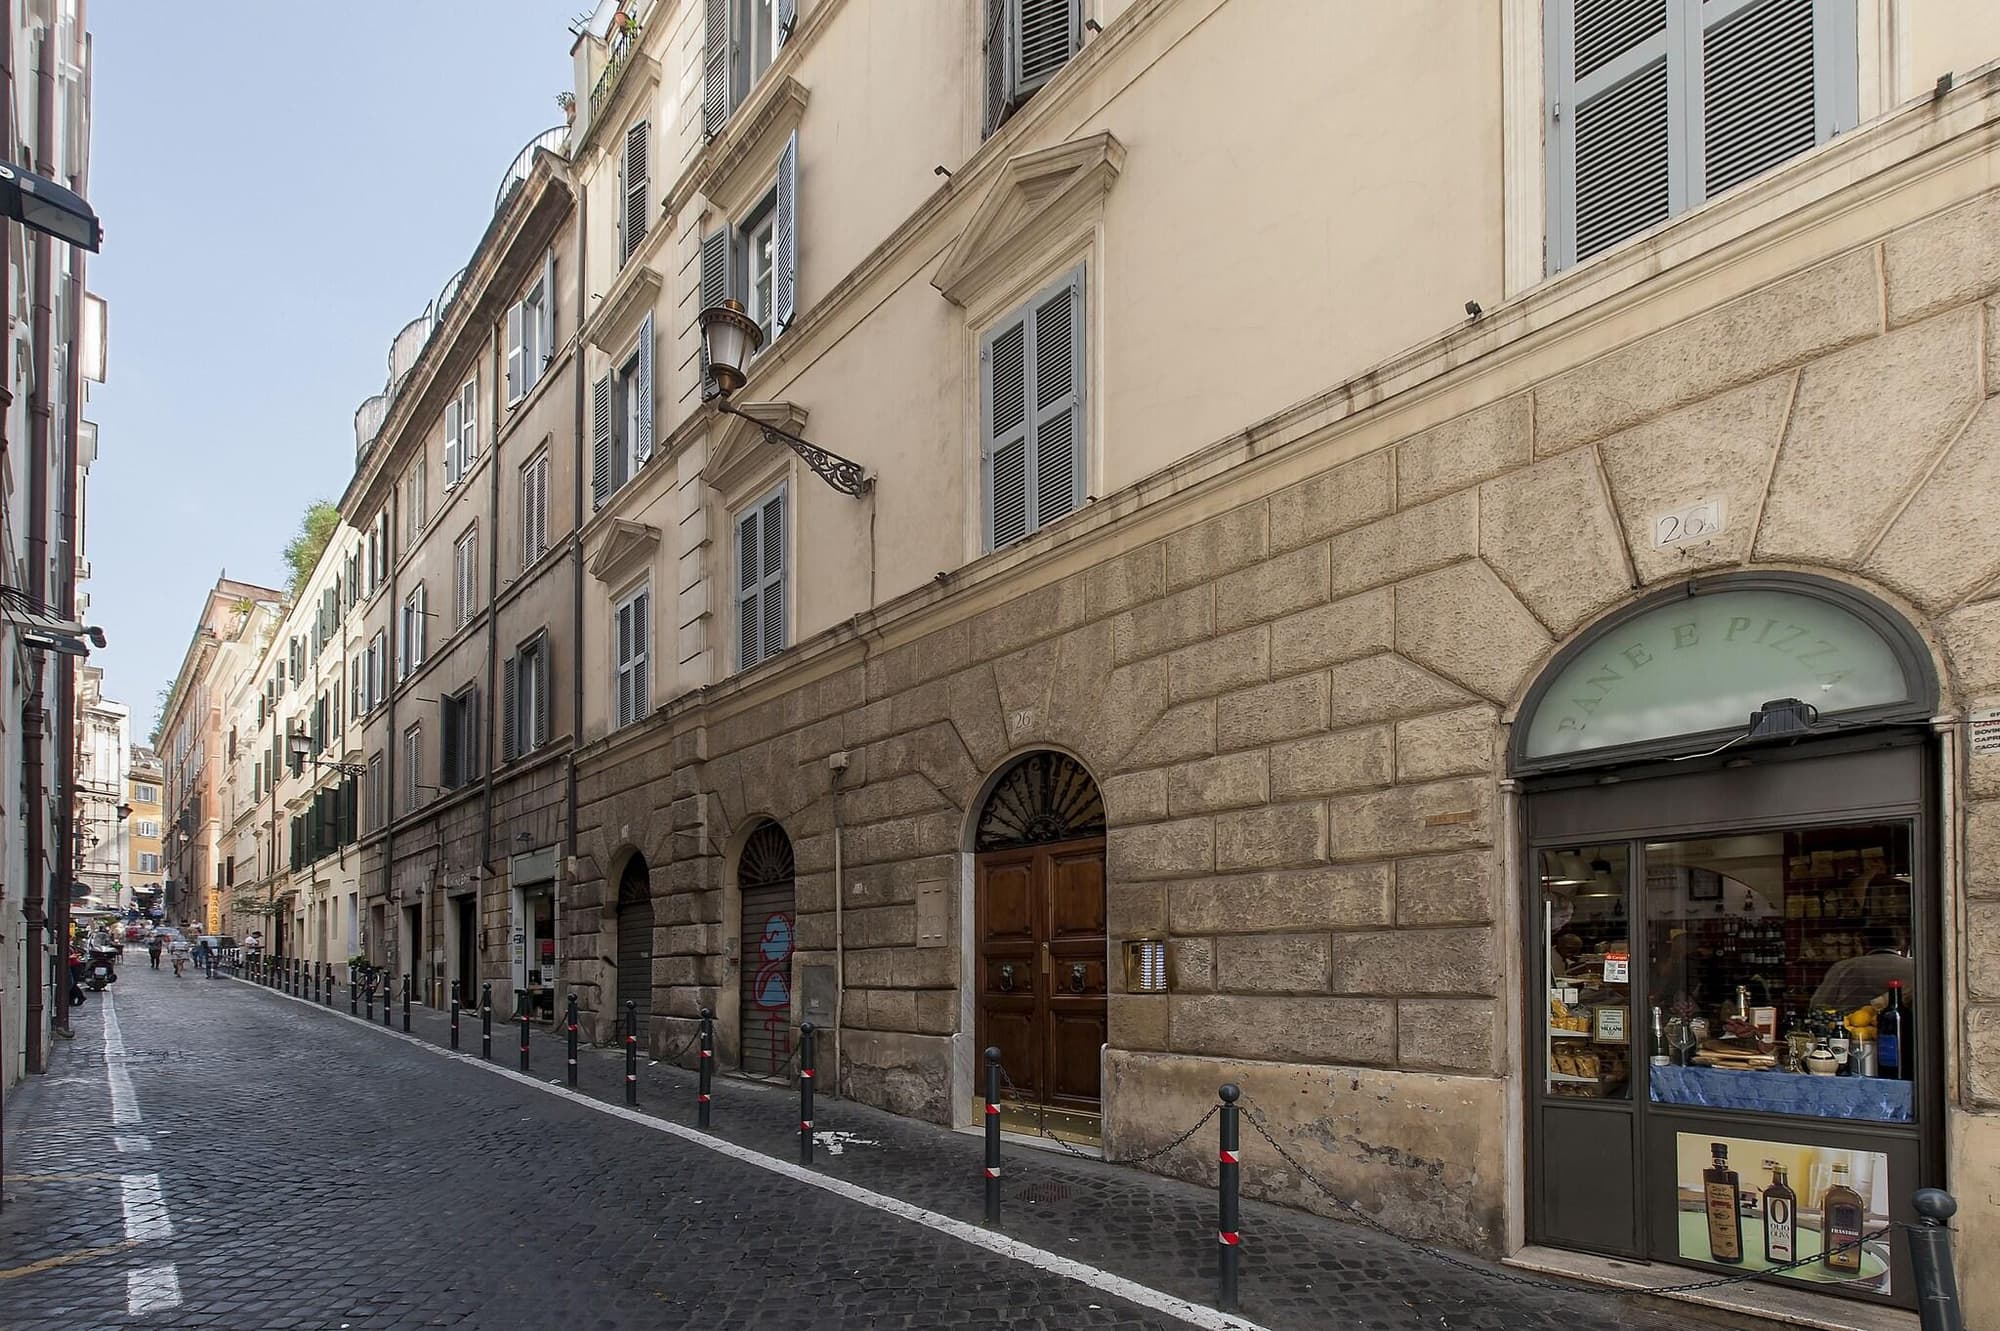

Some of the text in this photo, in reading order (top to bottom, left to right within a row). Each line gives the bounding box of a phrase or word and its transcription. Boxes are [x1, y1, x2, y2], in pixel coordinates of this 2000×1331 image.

[1558, 616, 1854, 733] PANE E PIZZA
[1015, 711, 1031, 729] 26
